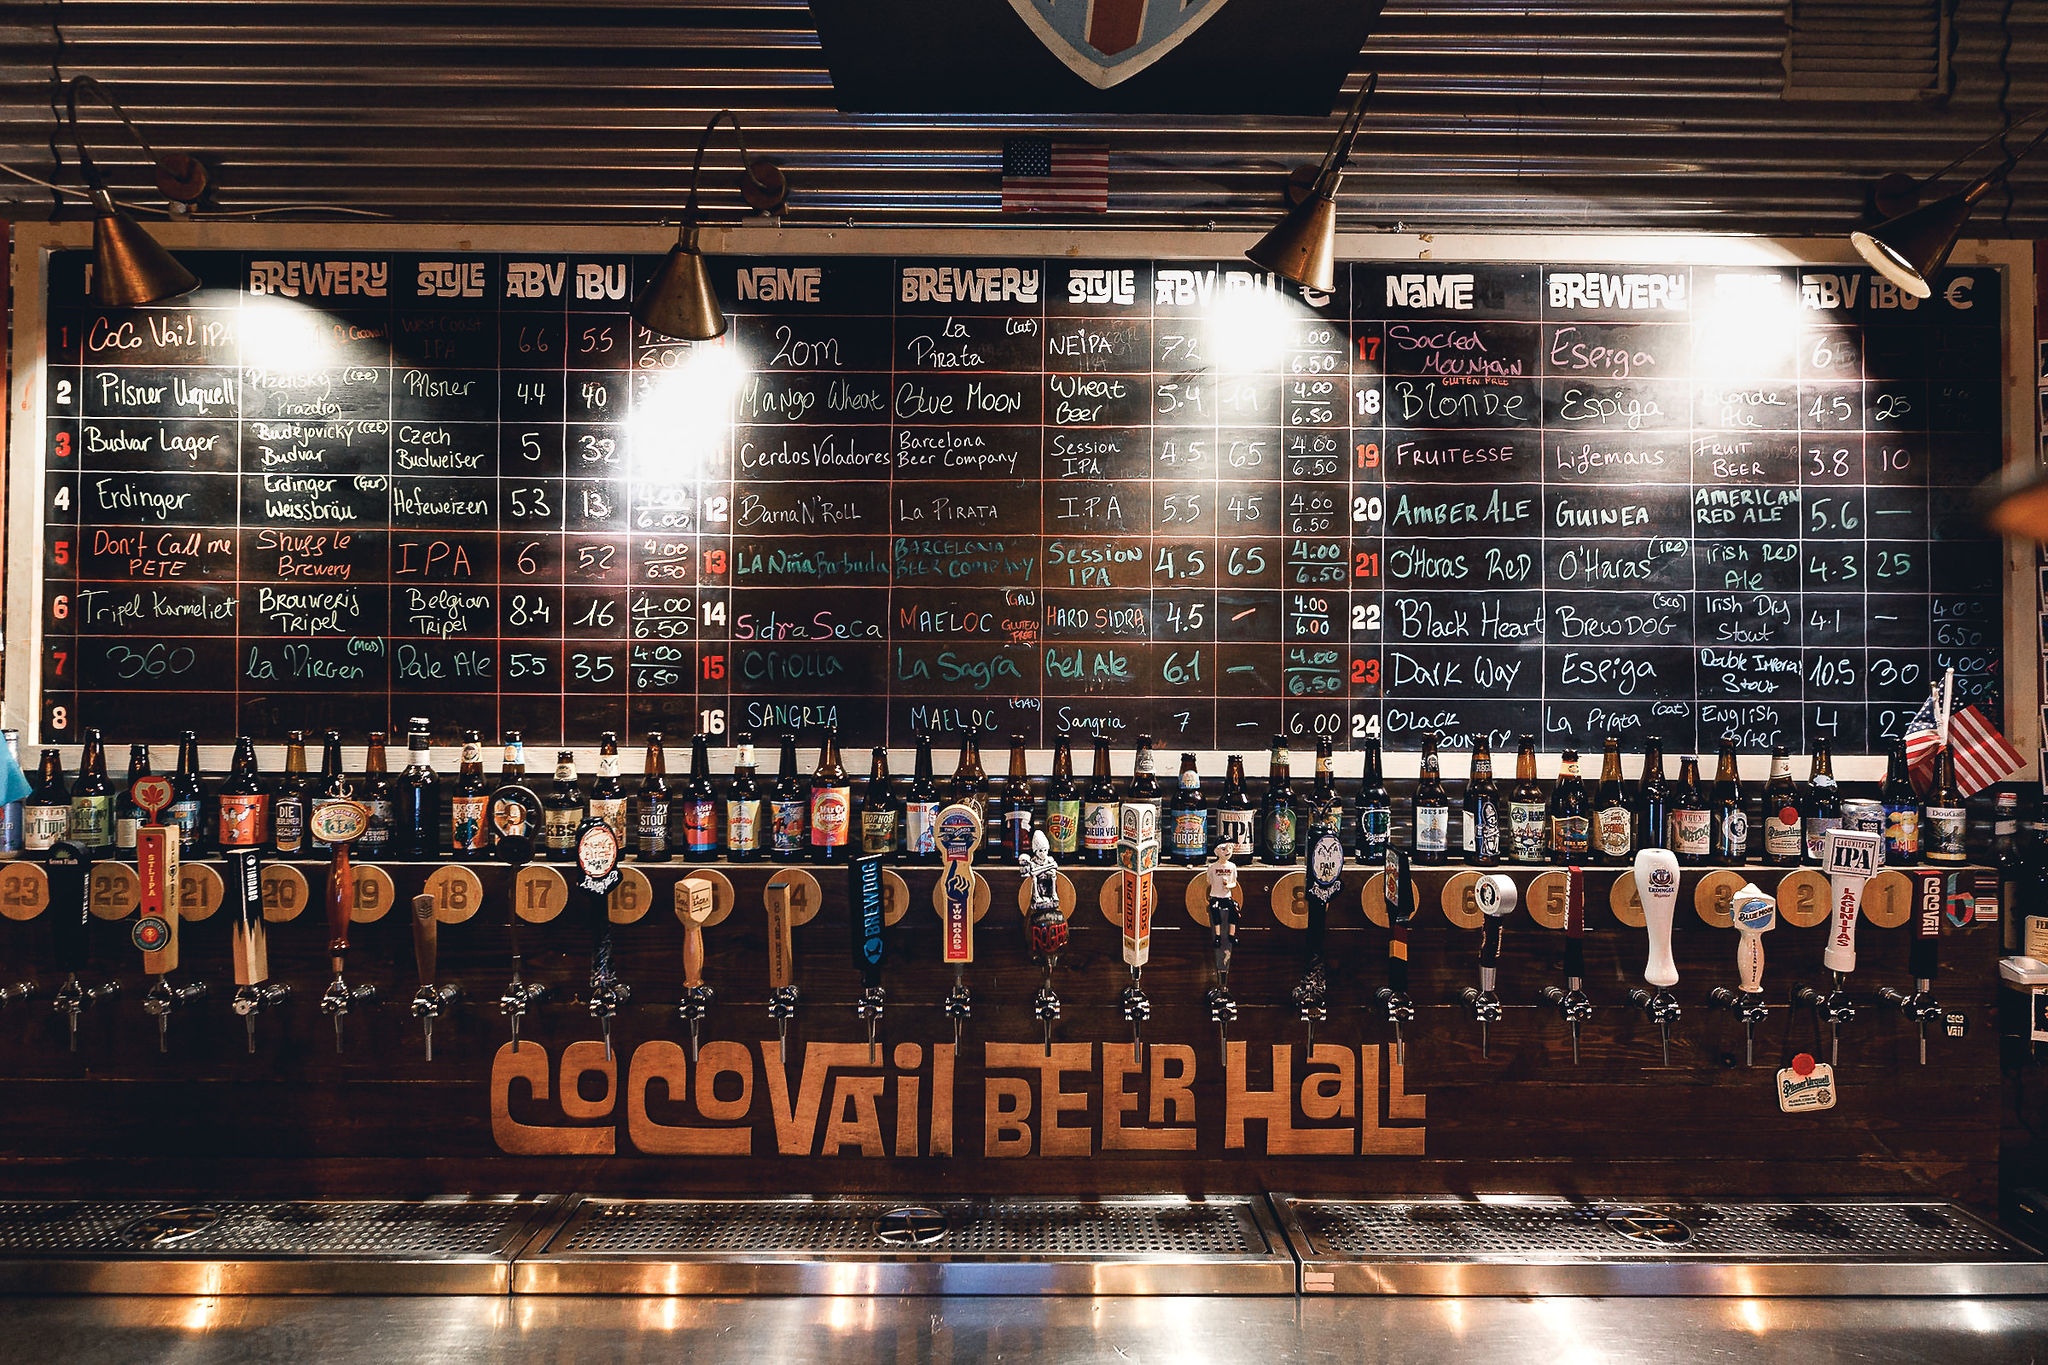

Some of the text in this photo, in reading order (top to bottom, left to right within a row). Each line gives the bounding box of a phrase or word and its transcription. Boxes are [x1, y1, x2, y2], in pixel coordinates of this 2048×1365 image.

[251, 261, 387, 297] BREWERY
[417, 262, 486, 297] STYLE
[506, 262, 567, 298] ABV
[902, 267, 1039, 303] BREWERY
[1067, 269, 1136, 305] STYLE
[1549, 273, 1687, 309] BREWERY
[1801, 274, 1859, 310] ABV
[1357, 336, 1380, 361] 17
[1390, 326, 1487, 352] Sacred
[1551, 327, 1656, 379] Espiga
[57, 380, 71, 404] 2
[96, 373, 235, 415] Pilsner Urquell
[402, 369, 477, 397] Pilsner
[1050, 375, 1126, 398] Wheat
[276, 392, 342, 420] Prazdroj
[740, 379, 886, 420] Mango Wheat
[895, 382, 954, 418] Blue
[1056, 402, 1102, 424] Beer
[1356, 389, 1380, 415] 18
[1561, 389, 1664, 429] Espiga
[55, 432, 71, 456] 3
[84, 426, 218, 459] Budvar Lager
[399, 425, 451, 446] Czech
[900, 431, 986, 449] Barcelona
[1051, 435, 1120, 456] Session
[1694, 434, 1752, 457] FRUIT
[260, 447, 326, 466] Budvar
[396, 444, 485, 470] Budweiser
[740, 434, 891, 467] Cerdos Voladores
[897, 449, 1018, 474] Beer Company
[1356, 443, 1379, 469] 19
[1397, 442, 1514, 466] FRUITESSE
[1062, 458, 1100, 477] IPA
[1711, 459, 1765, 478] BEER
[264, 475, 337, 493] Erdinger
[1695, 487, 1800, 507] AMERICAN
[54, 487, 70, 511] 4
[97, 479, 191, 520] Erdinger
[265, 499, 357, 522] Weissbräu
[394, 487, 489, 516] Hefeweizen
[704, 497, 728, 522] 12
[900, 498, 999, 521] La PIRATA
[1353, 497, 1382, 522] 20
[1392, 489, 1532, 526] AMBER ALE
[1555, 499, 1650, 527] GUINEA
[1697, 505, 1783, 525] RED ALE
[54, 542, 69, 565] 5
[94, 530, 232, 557] Don't Call me
[895, 539, 1004, 557] BARCELONA
[1048, 543, 1143, 565] Session
[1706, 543, 1749, 565] Irish
[129, 559, 187, 577] PETE
[278, 556, 351, 579] Brewery
[517, 542, 540, 575] 6
[703, 550, 727, 574] 13
[737, 553, 767, 574] LA
[896, 558, 944, 579] BEER
[1356, 552, 1379, 577] 21
[1558, 546, 1651, 581] O'Haras
[1069, 567, 1111, 587] IPA
[1724, 569, 1764, 591] Ale
[53, 595, 68, 619] 6
[77, 590, 239, 626] Tripel Karmeliet
[406, 588, 490, 619] Belgian
[702, 601, 726, 626] 14
[1706, 594, 1791, 625] Irish Dry
[270, 613, 346, 636] Tripel
[410, 614, 467, 640] Tripel
[735, 611, 883, 640] Sidra Seca
[900, 605, 994, 633] MAELOC
[1047, 605, 1144, 630] HARD SIDRA
[1352, 605, 1380, 630] 22
[1395, 599, 1545, 638] Black Heart
[1716, 623, 1774, 643] Stout
[53, 652, 68, 675] 7
[106, 644, 195, 679] 360
[398, 645, 492, 679] Pale Ale
[572, 654, 615, 682] 35
[702, 655, 725, 680] 15
[898, 648, 1021, 689] La Sagra
[1046, 649, 1128, 678] Red Ale
[1351, 659, 1380, 684] 23
[1391, 652, 1522, 691] Dark Way
[1700, 648, 1748, 672] Double
[1561, 653, 1657, 695] Espiga
[52, 705, 67, 730] 8
[700, 709, 725, 734] 16
[748, 702, 838, 730] SANGRIA
[911, 705, 999, 731] MAELOC
[1057, 707, 1126, 740] Sangria
[1351, 714, 1380, 738] 24
[1546, 706, 1641, 734] La Pirata
[1701, 705, 1778, 734] English
[279, 806, 294, 818] DIE
[656, 804, 669, 815] 2X
[1836, 838, 1869, 848] LAGUNITAS
[1834, 846, 1871, 870] IPA
[4, 876, 40, 906] 23
[95, 877, 130, 906] 22
[180, 879, 208, 907] 21
[246, 865, 258, 901] TIBIDABO
[263, 879, 296, 908] 20
[352, 879, 379, 908] 19
[438, 879, 468, 909] 18
[524, 879, 552, 909] 17
[611, 881, 637, 910] 16
[862, 861, 880, 937] BREWDOG
[1140, 880, 1148, 931] SCULPIN
[1291, 885, 1309, 915] 8
[1462, 886, 1479, 915] 6
[1546, 886, 1564, 914] 5
[1714, 884, 1732, 913] 3
[1797, 884, 1813, 914] 2
[1885, 886, 1895, 914] 1
[953, 903, 962, 950] TWO ROADS
[1738, 909, 1758, 922] BLUE
[1837, 888, 1856, 948] LAGUNITAS
[985, 1042, 1197, 1157] BEER
